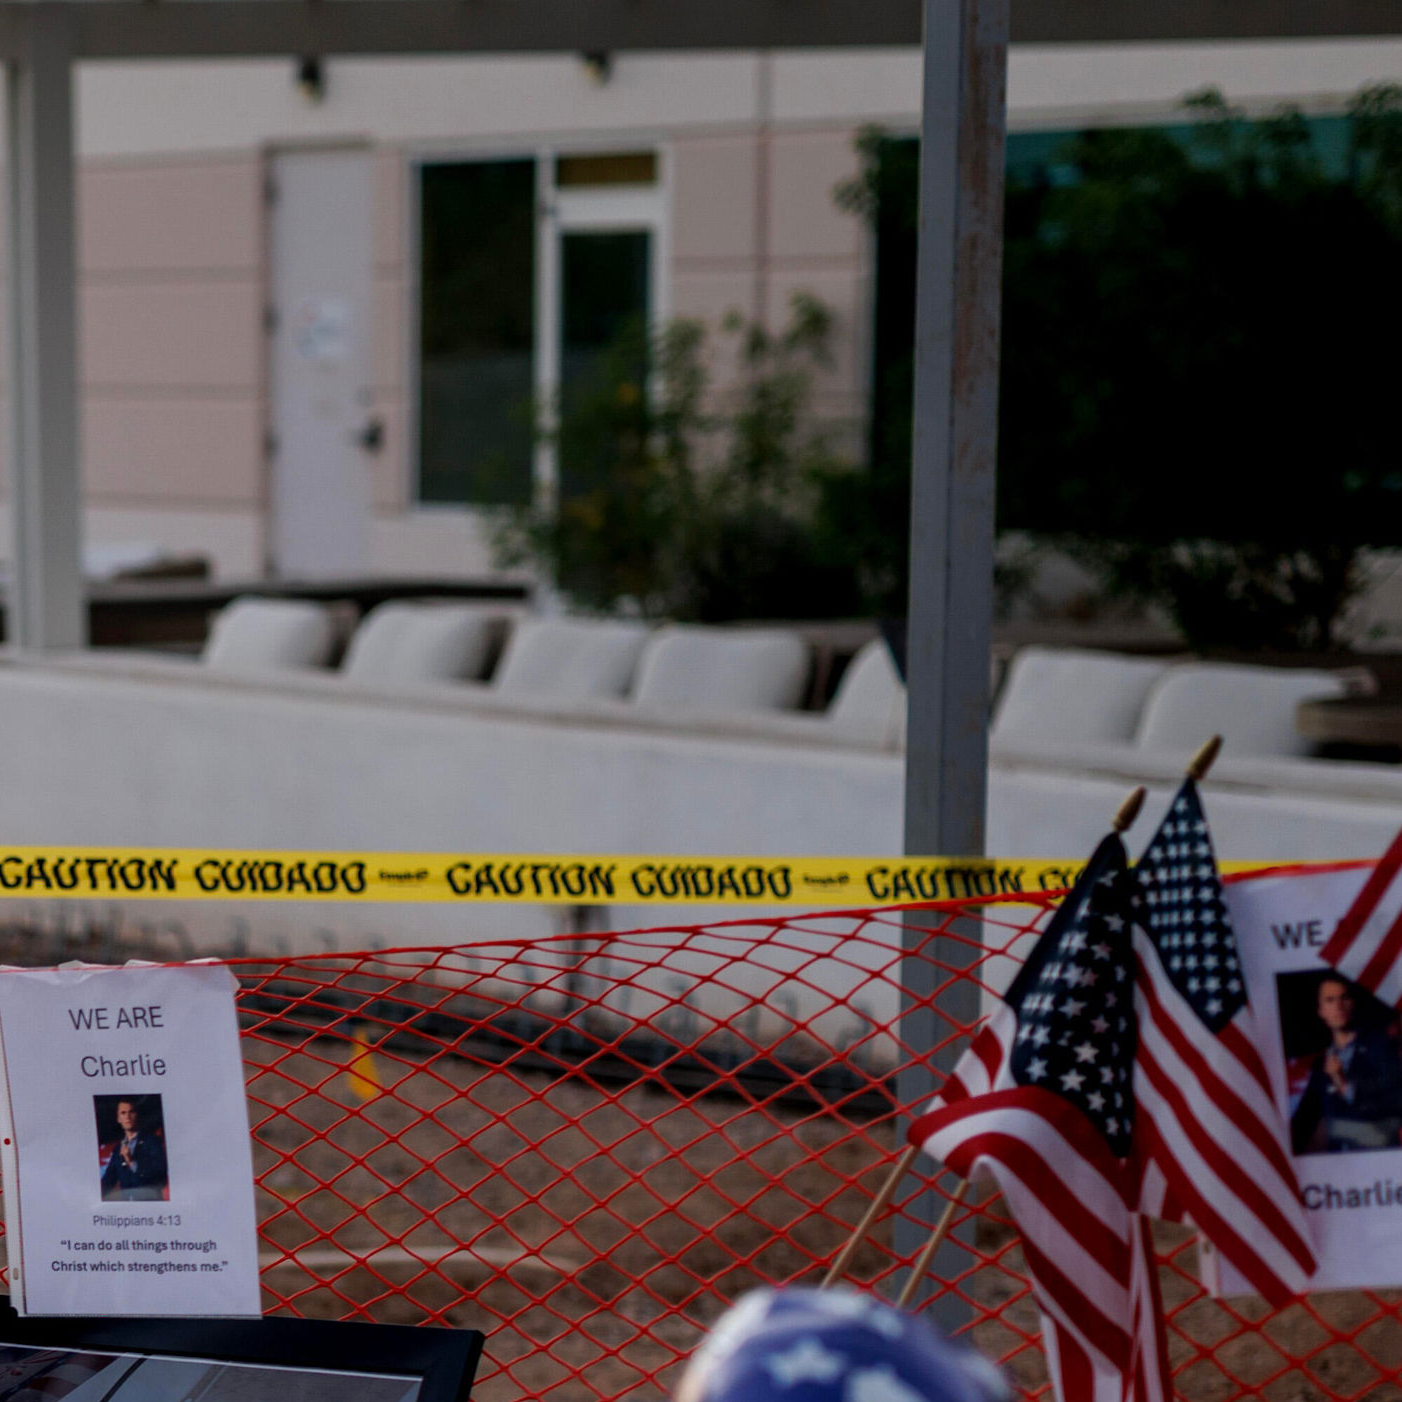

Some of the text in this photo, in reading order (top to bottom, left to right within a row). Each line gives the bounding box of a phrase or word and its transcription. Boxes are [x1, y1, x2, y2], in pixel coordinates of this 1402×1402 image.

[194, 859, 367, 894] CUIDADO
[446, 861, 616, 897] CAUTION
[631, 863, 793, 899] CUIDADO
[866, 864, 1027, 901] CAUTION
[68, 1005, 165, 1031] WE ARE
[81, 1054, 166, 1078] Charlie
[92, 1214, 182, 1229] Philippians 4:13
[74, 1241, 96, 1251] can
[97, 1239, 113, 1251] do
[115, 1239, 130, 1251] all
[131, 1239, 168, 1254] things
[170, 1239, 217, 1254] through
[51, 1260, 88, 1272] Christ
[90, 1260, 125, 1272] which
[127, 1260, 197, 1275] strengthens
